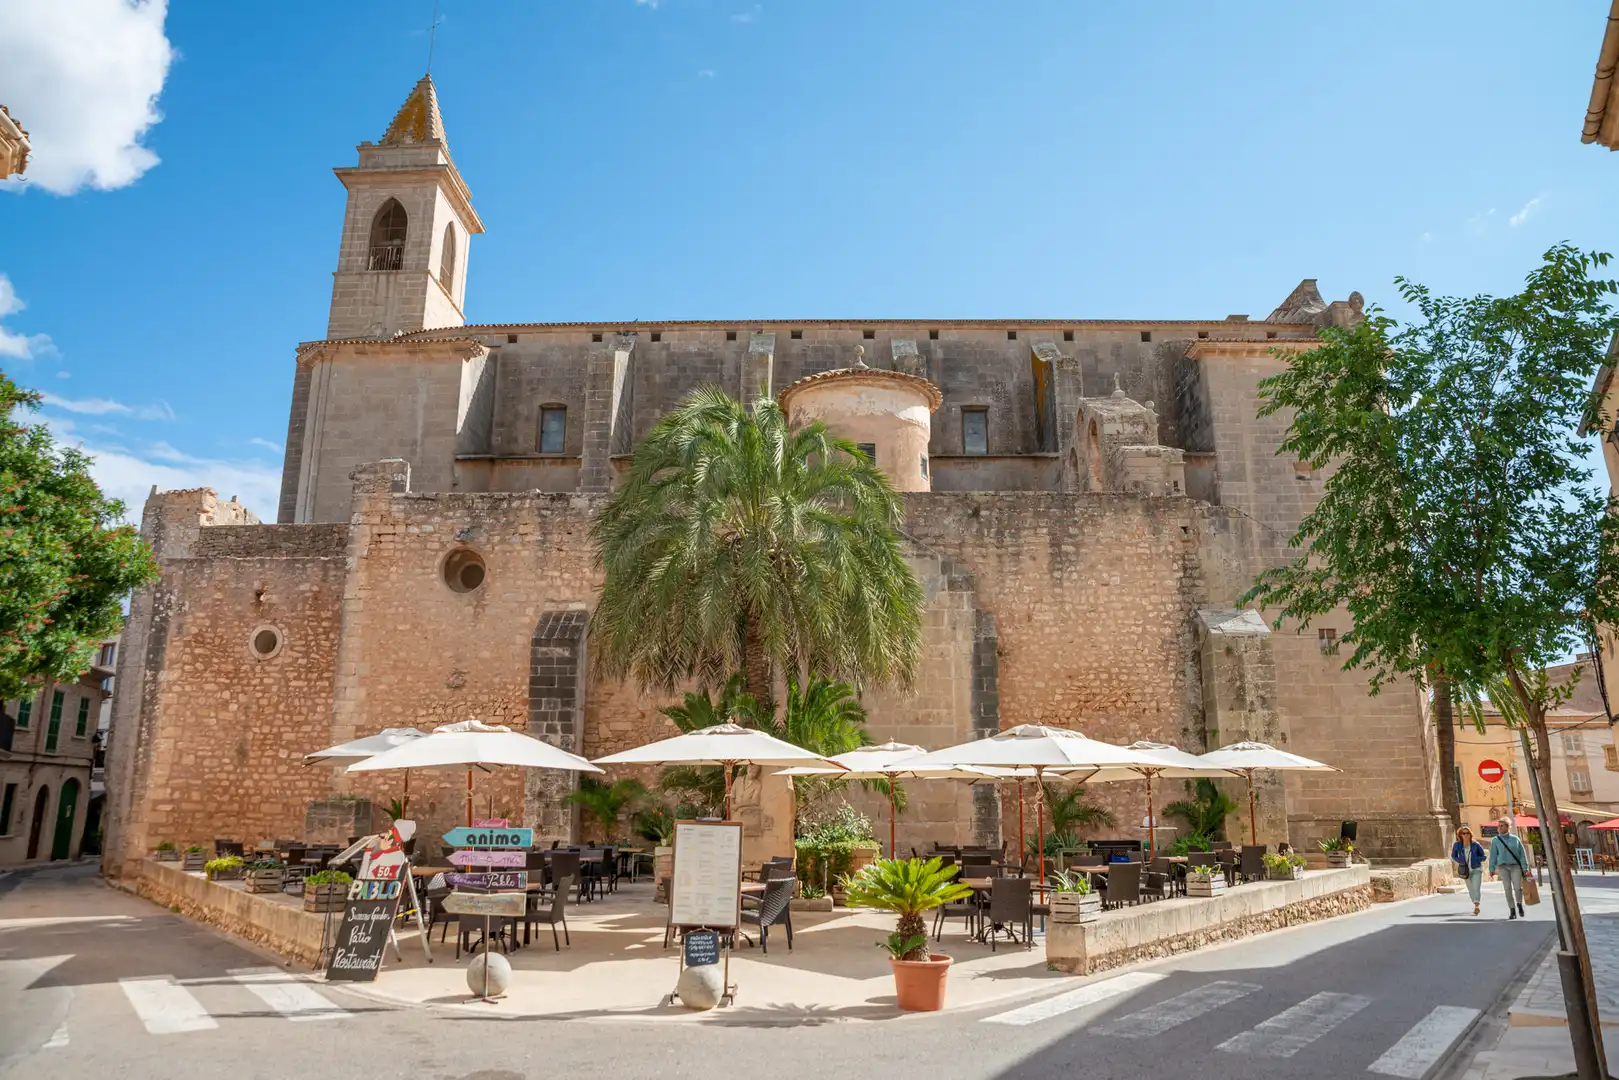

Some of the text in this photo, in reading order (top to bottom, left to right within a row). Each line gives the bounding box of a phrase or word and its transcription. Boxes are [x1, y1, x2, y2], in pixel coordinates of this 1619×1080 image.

[466, 829, 521, 845] animo
[347, 880, 401, 900] PABLO
[486, 873, 516, 888] Pablo
[348, 923, 372, 946] Patio
[332, 947, 381, 970] Restaurant
